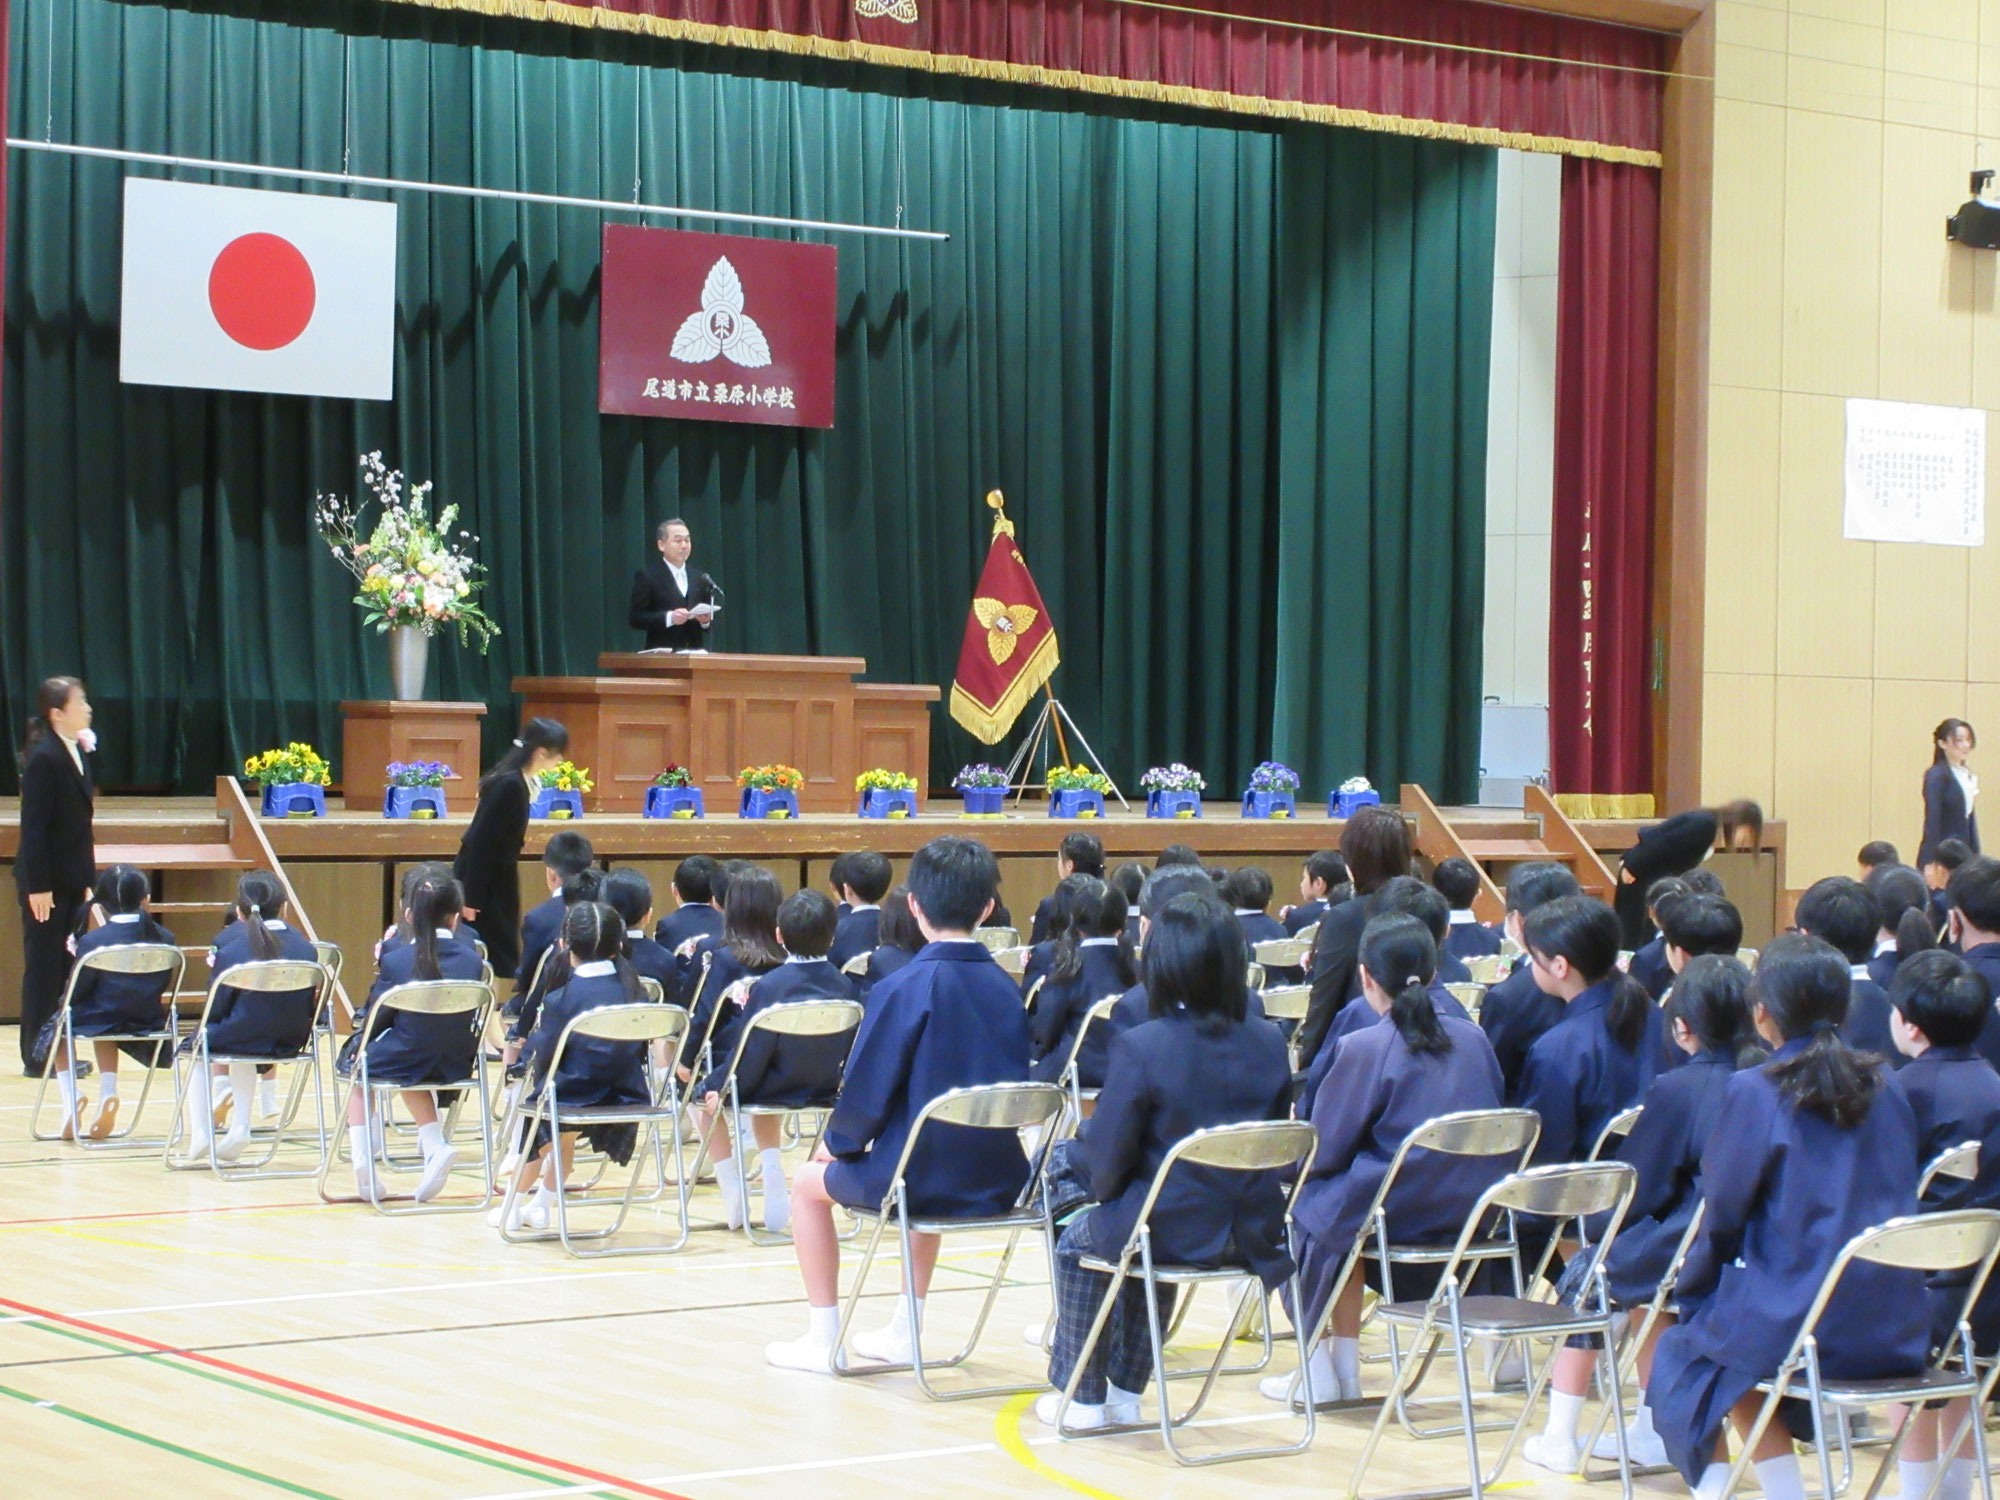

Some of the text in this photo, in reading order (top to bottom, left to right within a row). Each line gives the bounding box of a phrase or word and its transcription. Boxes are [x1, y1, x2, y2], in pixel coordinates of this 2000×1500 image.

[642, 377, 796, 409] 尾道市立栗原小学校
